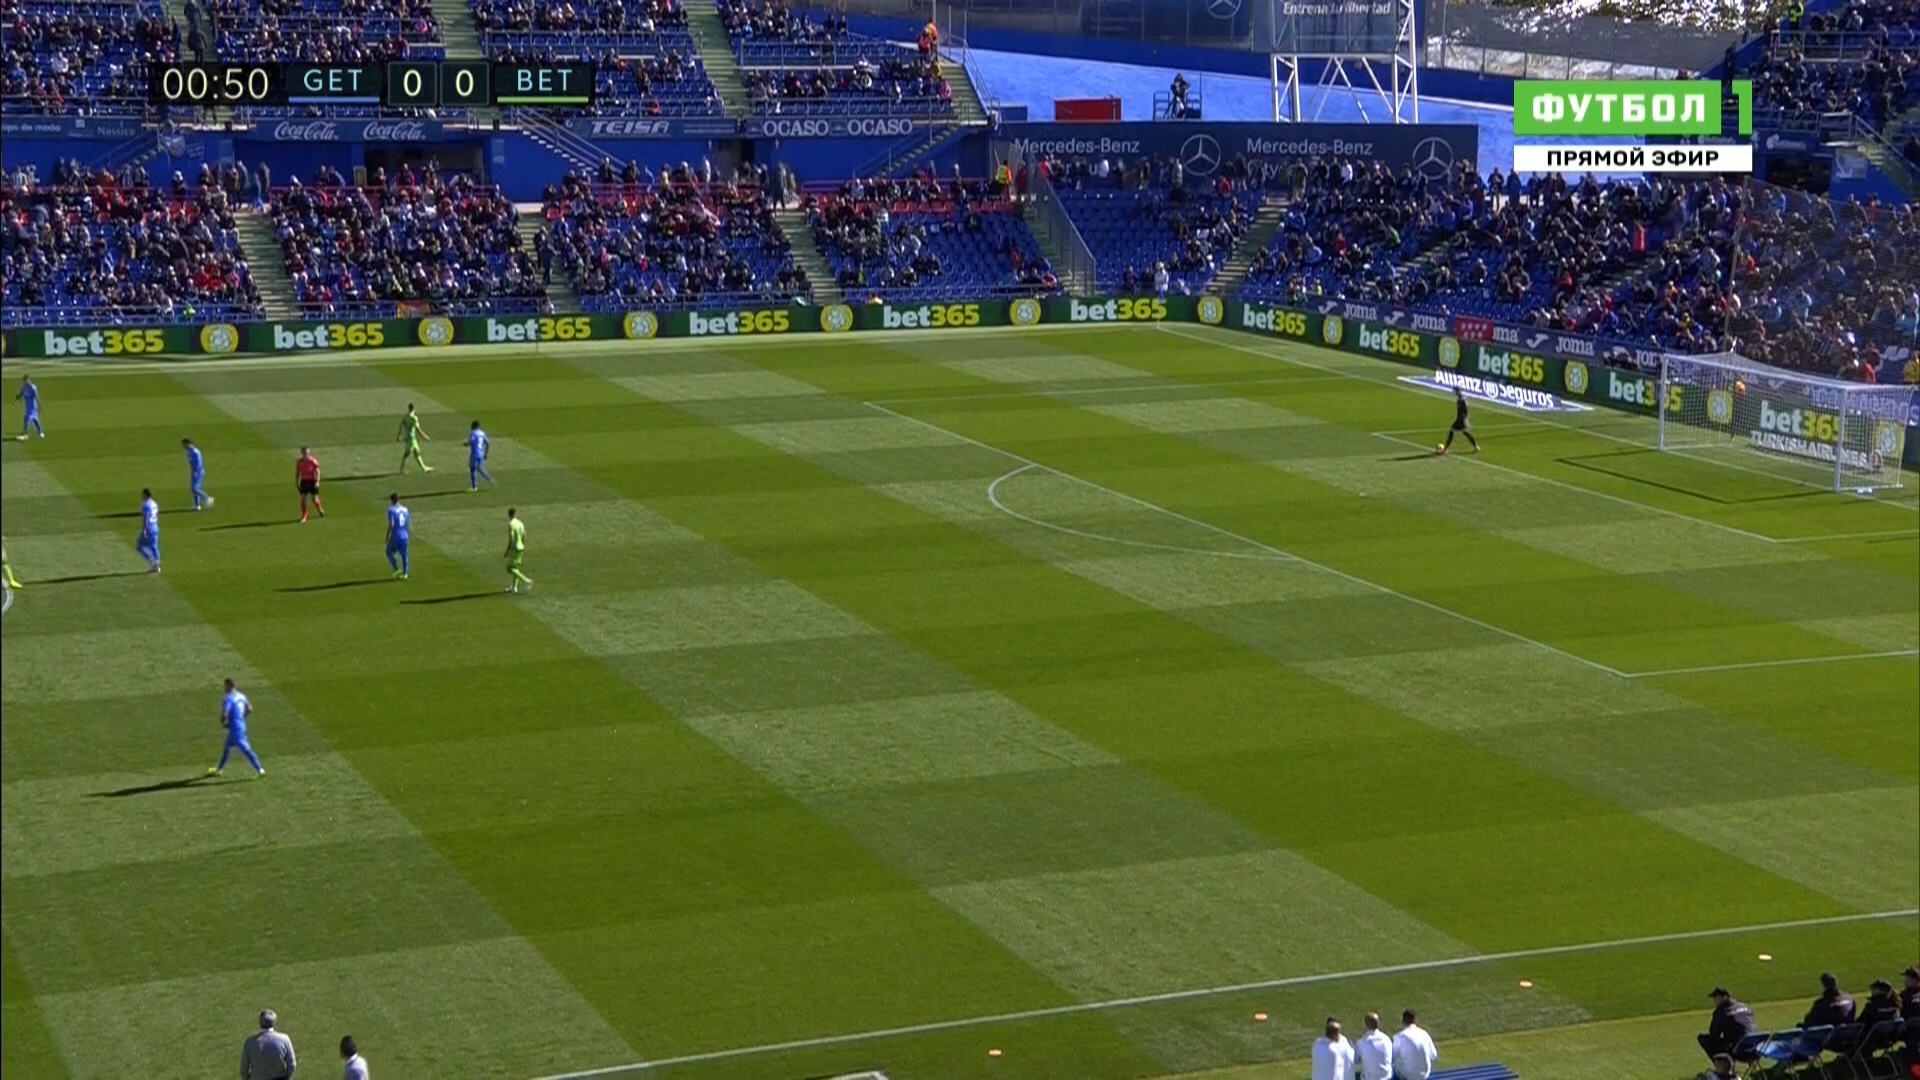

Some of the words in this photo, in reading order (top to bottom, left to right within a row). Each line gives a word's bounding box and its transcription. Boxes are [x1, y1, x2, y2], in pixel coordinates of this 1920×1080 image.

[1283, 1, 1328, 15] Entrena
[97, 121, 135, 137] Nassica
[591, 120, 670, 134] TEISA
[763, 119, 829, 137] OCASO
[847, 118, 913, 136] OCASO
[1014, 137, 1140, 154] Mercedes-Benz
[1247, 137, 1373, 155] Mercedes-Benz
[44, 329, 165, 355] bet365
[273, 323, 385, 349] bet365
[487, 317, 592, 342] bet365
[689, 310, 789, 335] bet365
[883, 304, 980, 328] bet365
[1070, 298, 1167, 322] bet365
[1243, 304, 1307, 336] bet365
[1359, 324, 1420, 358] bet365
[1478, 346, 1544, 383] bet365
[1609, 371, 1682, 411] bet35
[1435, 369, 1482, 393] Allianz
